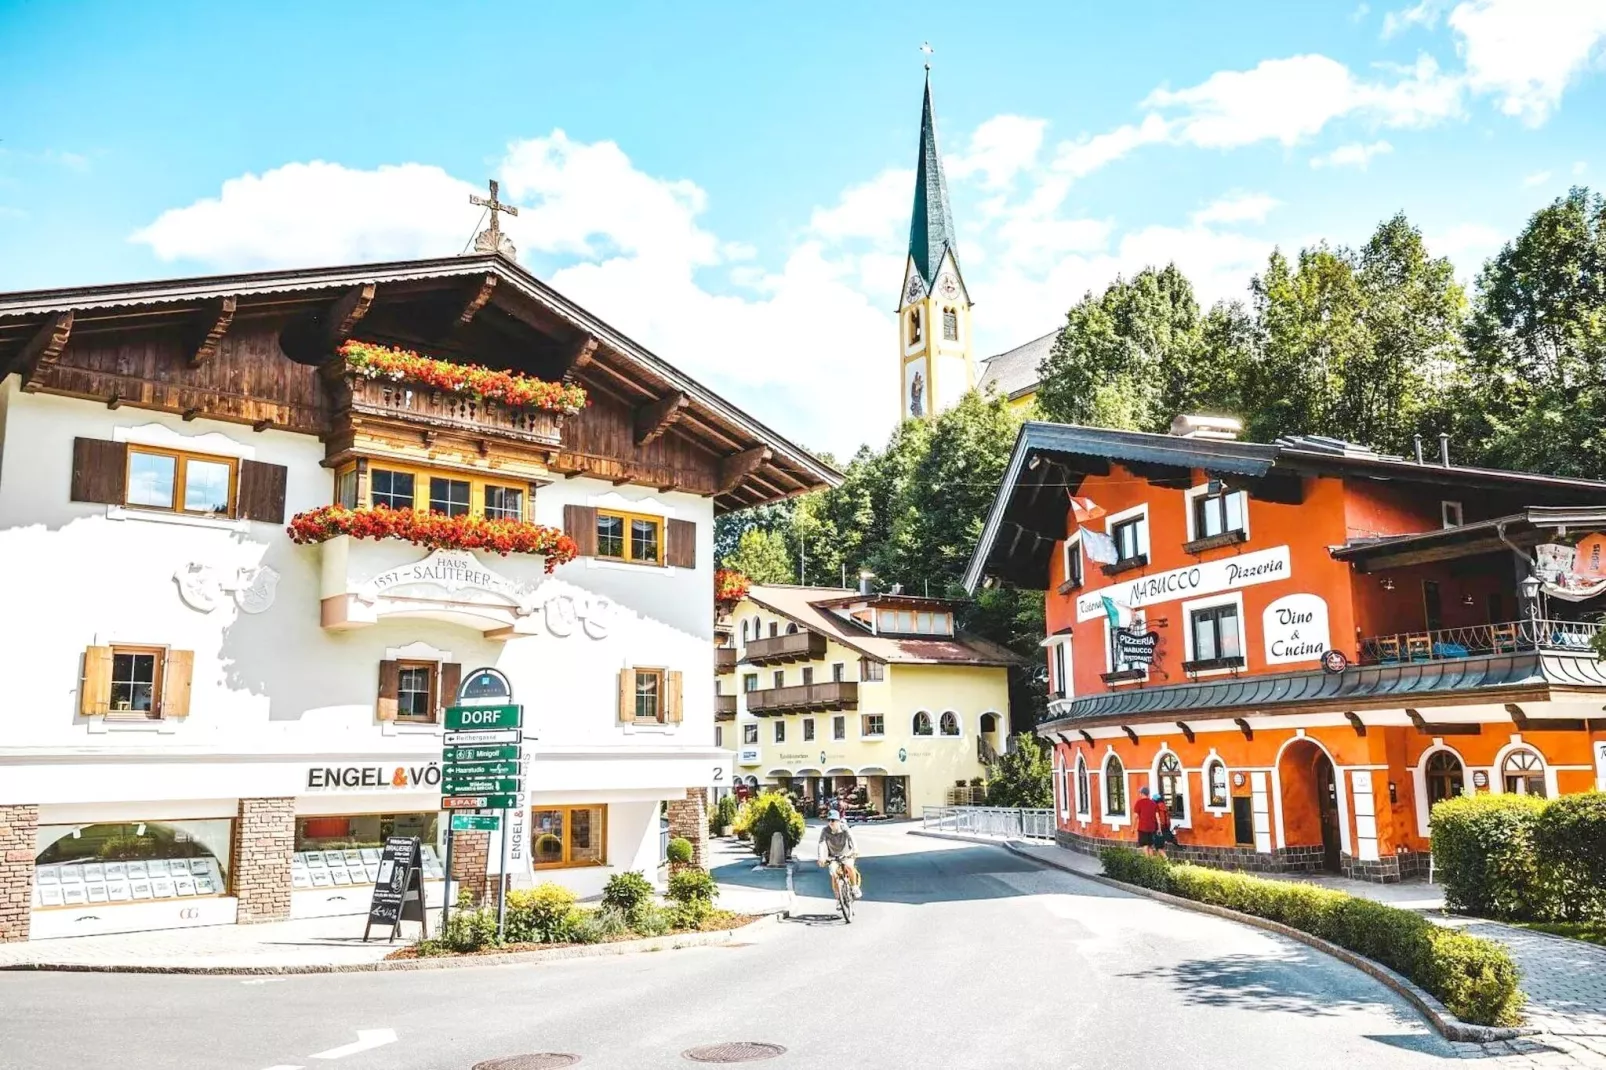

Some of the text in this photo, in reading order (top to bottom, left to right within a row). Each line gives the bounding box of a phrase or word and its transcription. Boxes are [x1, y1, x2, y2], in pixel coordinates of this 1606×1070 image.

[437, 557, 468, 569] HAUS
[413, 565, 491, 586] SALITERER
[1129, 567, 1201, 606] NABUCCO
[1225, 559, 1283, 585] Pizzeria
[1275, 607, 1313, 625] Vino
[1119, 634, 1156, 646] PIZZERIA
[1290, 629, 1300, 641] &
[1123, 646, 1153, 654] NABUCCO
[1271, 640, 1324, 657] Cucina
[461, 709, 502, 724] DORF
[476, 749, 500, 758] Minigolf
[307, 761, 441, 788] ENGEL&VÖ
[712, 767, 724, 781] 2
[450, 799, 477, 807] SPAR
